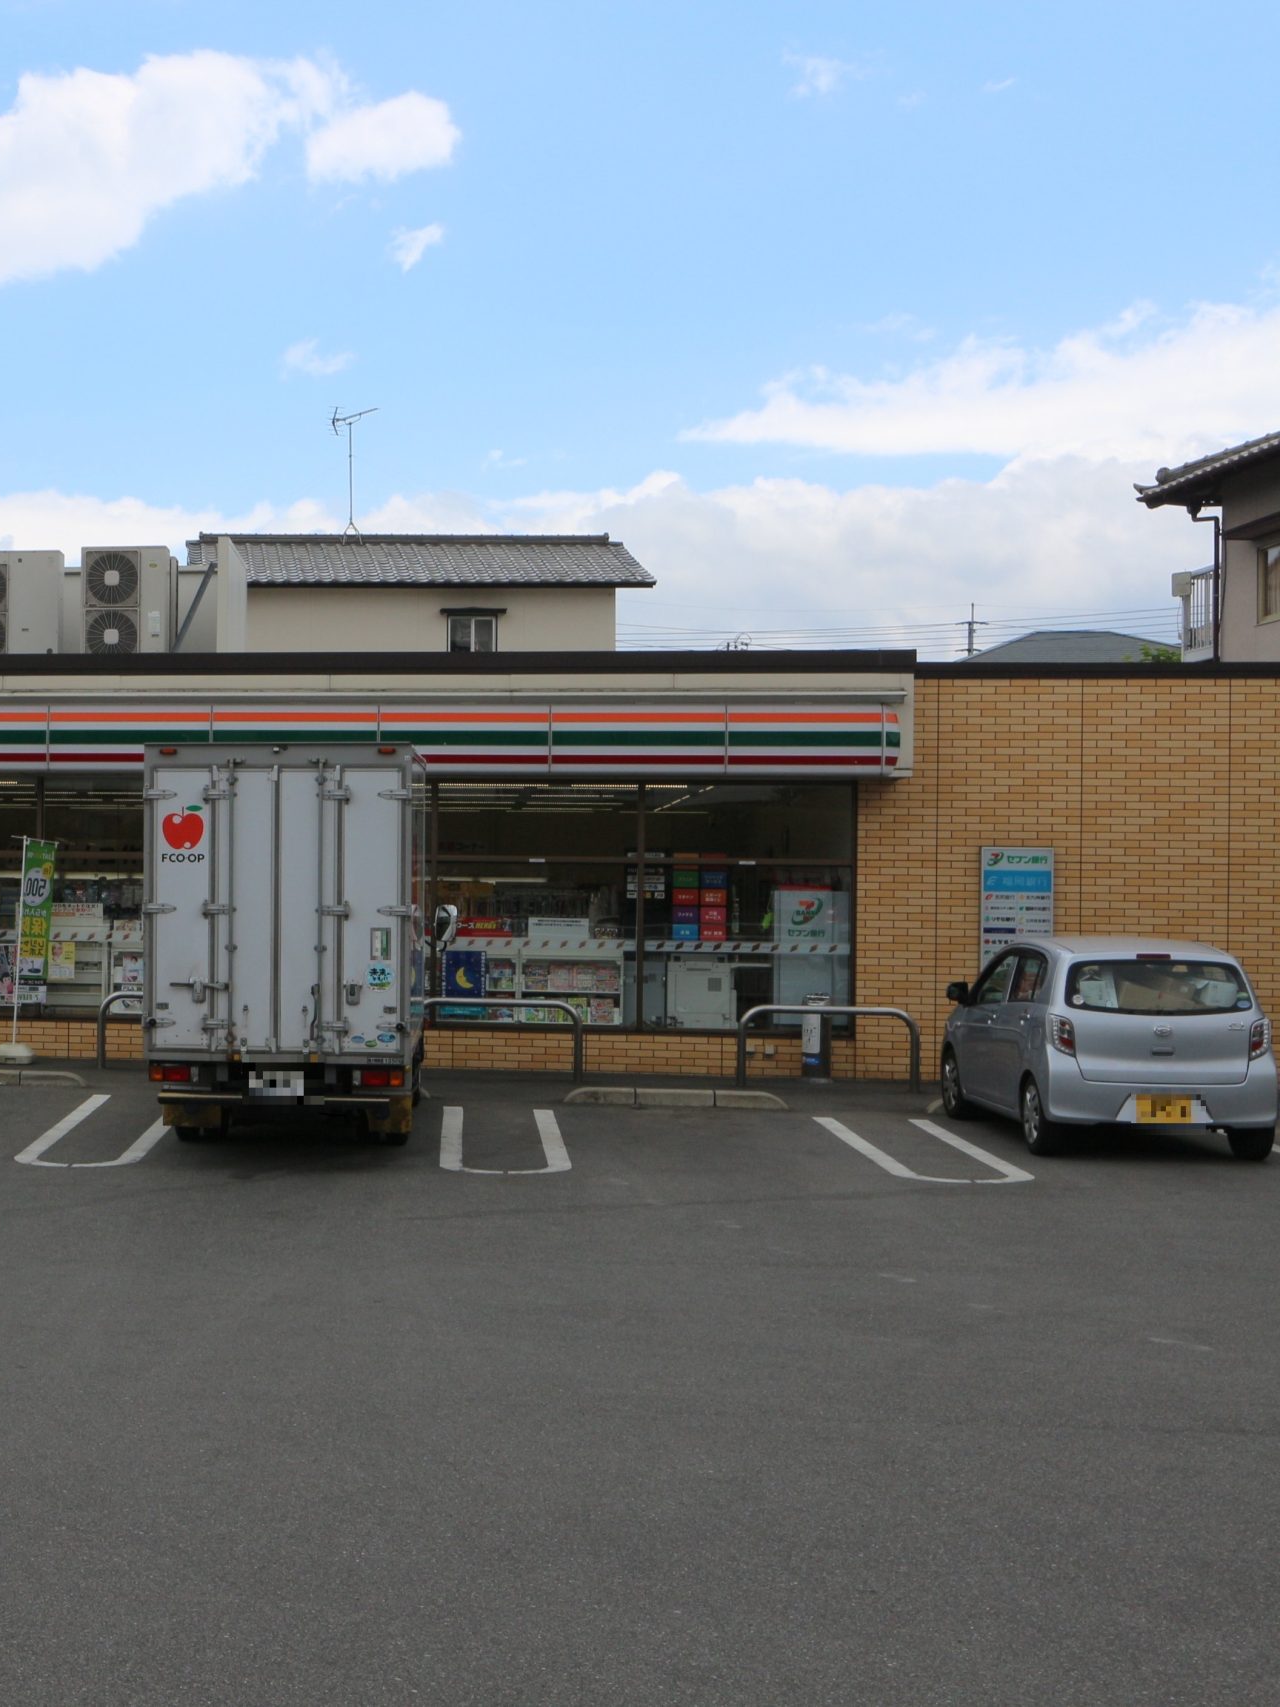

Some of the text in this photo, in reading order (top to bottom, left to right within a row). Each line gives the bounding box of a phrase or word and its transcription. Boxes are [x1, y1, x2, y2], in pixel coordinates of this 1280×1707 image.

[1007, 855, 1048, 864] セブン銀行
[788, 929, 825, 937] セブン銀行
